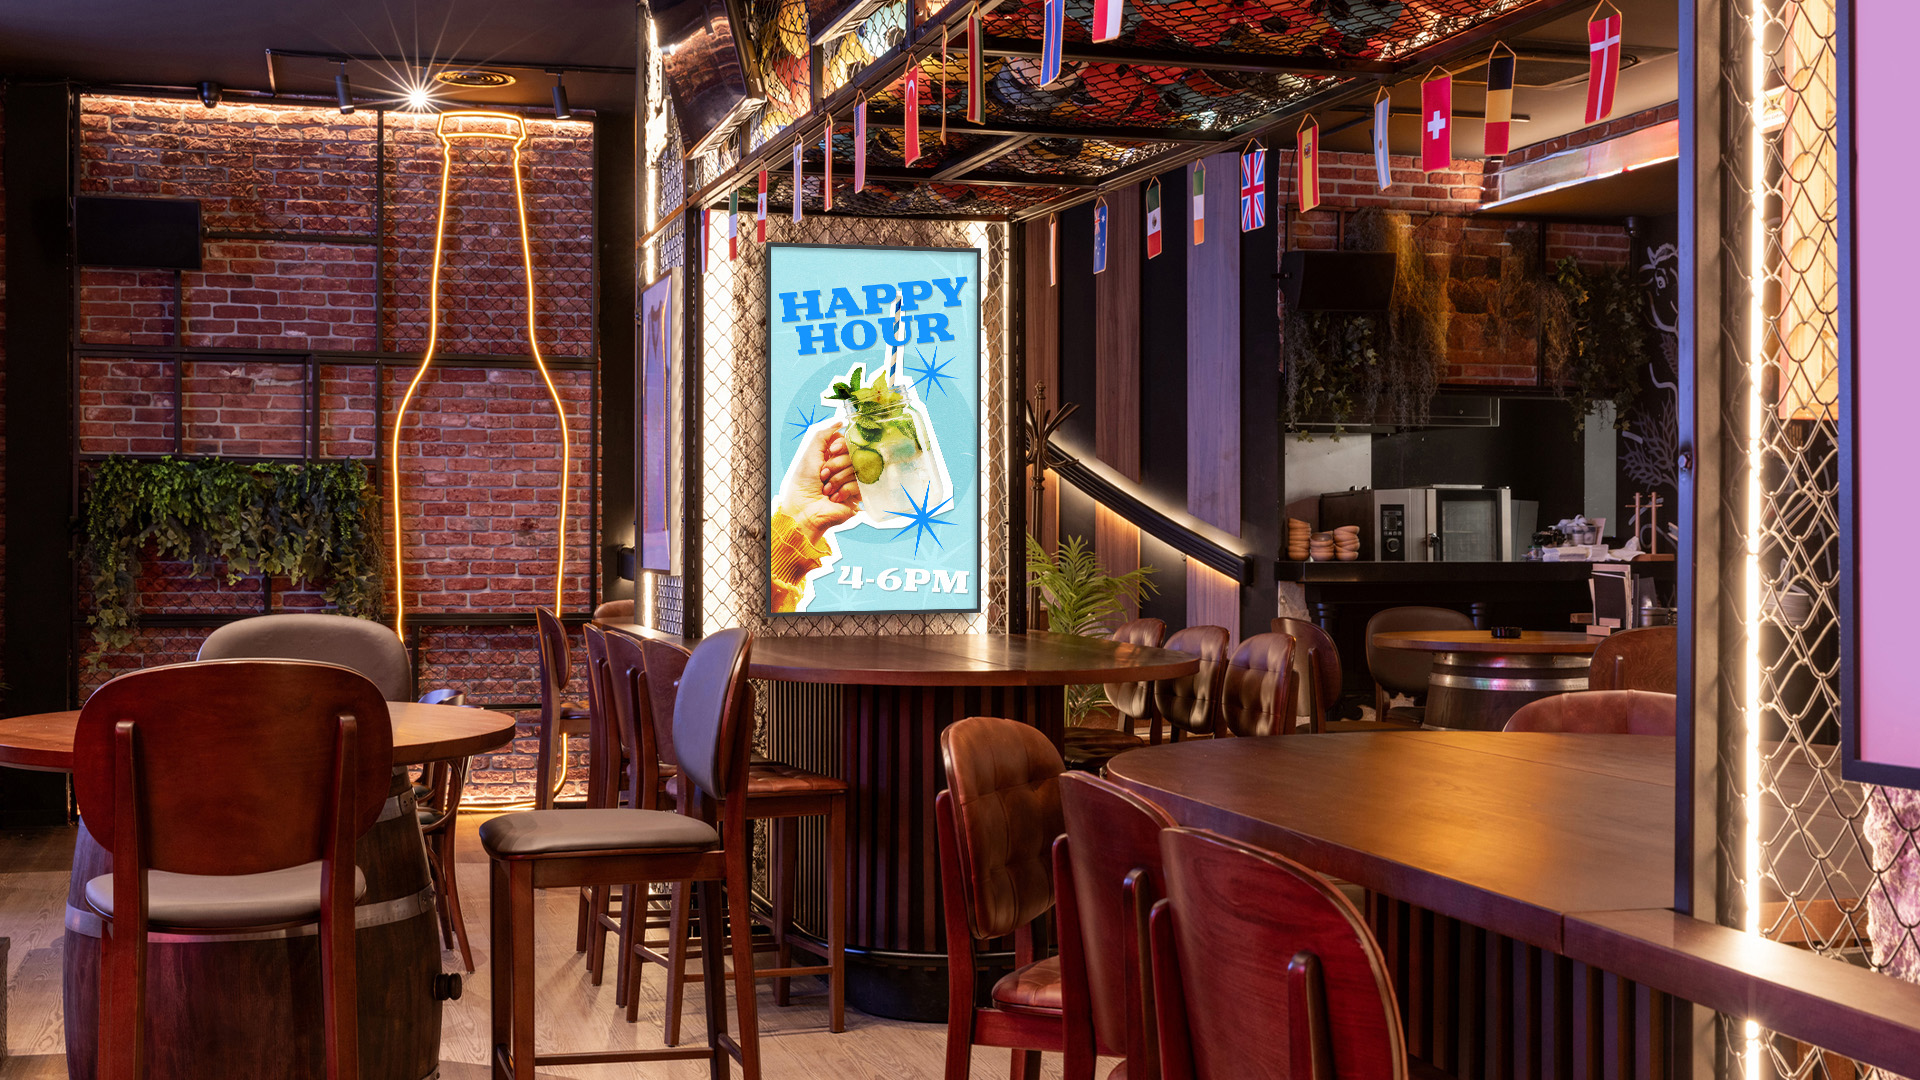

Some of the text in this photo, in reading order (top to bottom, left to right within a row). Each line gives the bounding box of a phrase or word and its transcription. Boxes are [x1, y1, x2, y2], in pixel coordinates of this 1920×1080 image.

[779, 277, 968, 323] HAPPY
[795, 313, 955, 356] HOUR
[838, 565, 970, 594] 4-6PM
